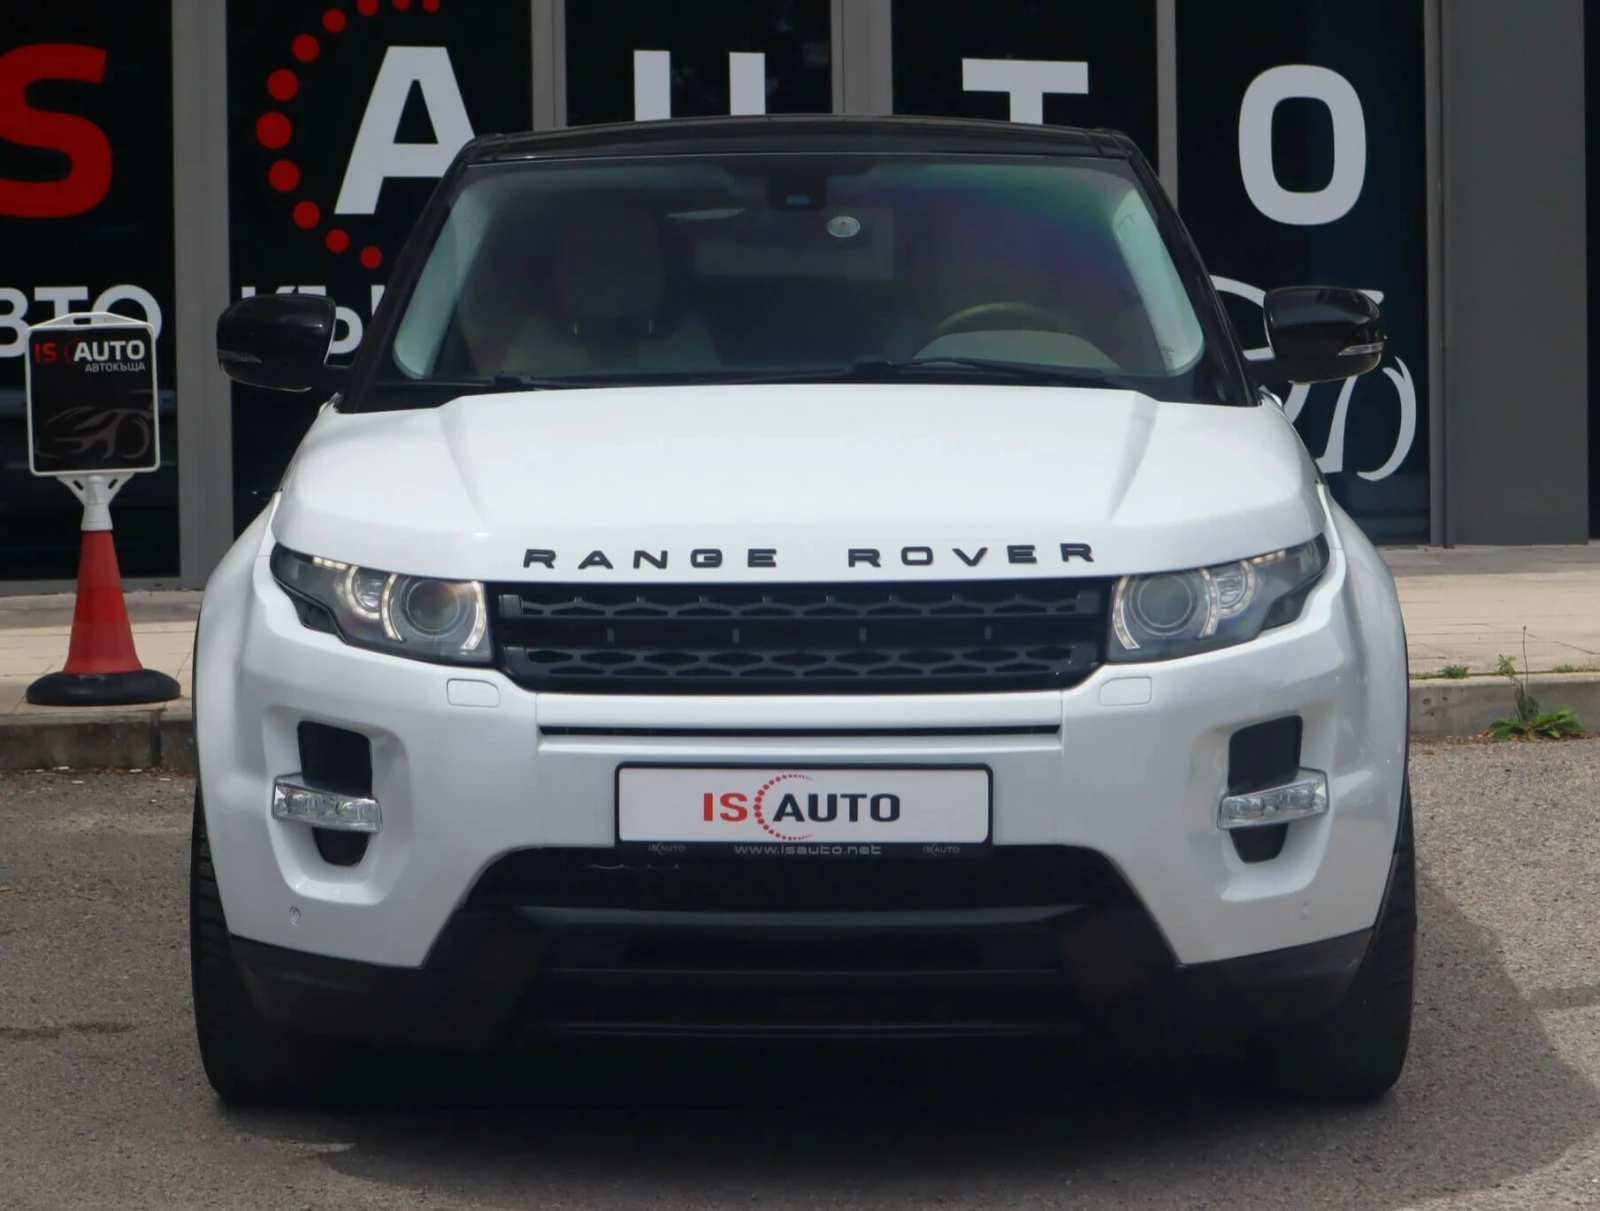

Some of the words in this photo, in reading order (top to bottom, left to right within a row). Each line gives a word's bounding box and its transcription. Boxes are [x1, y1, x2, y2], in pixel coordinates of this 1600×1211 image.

[34, 342, 58, 363] IS
[73, 339, 146, 362] AUTO
[85, 361, 146, 373] АВТОКЪЩА
[523, 548, 778, 570] RANGE
[848, 542, 1095, 568] ROVER
[703, 792, 748, 822] IS
[772, 793, 901, 822] AUTO
[734, 844, 882, 855] www.isauto.net
